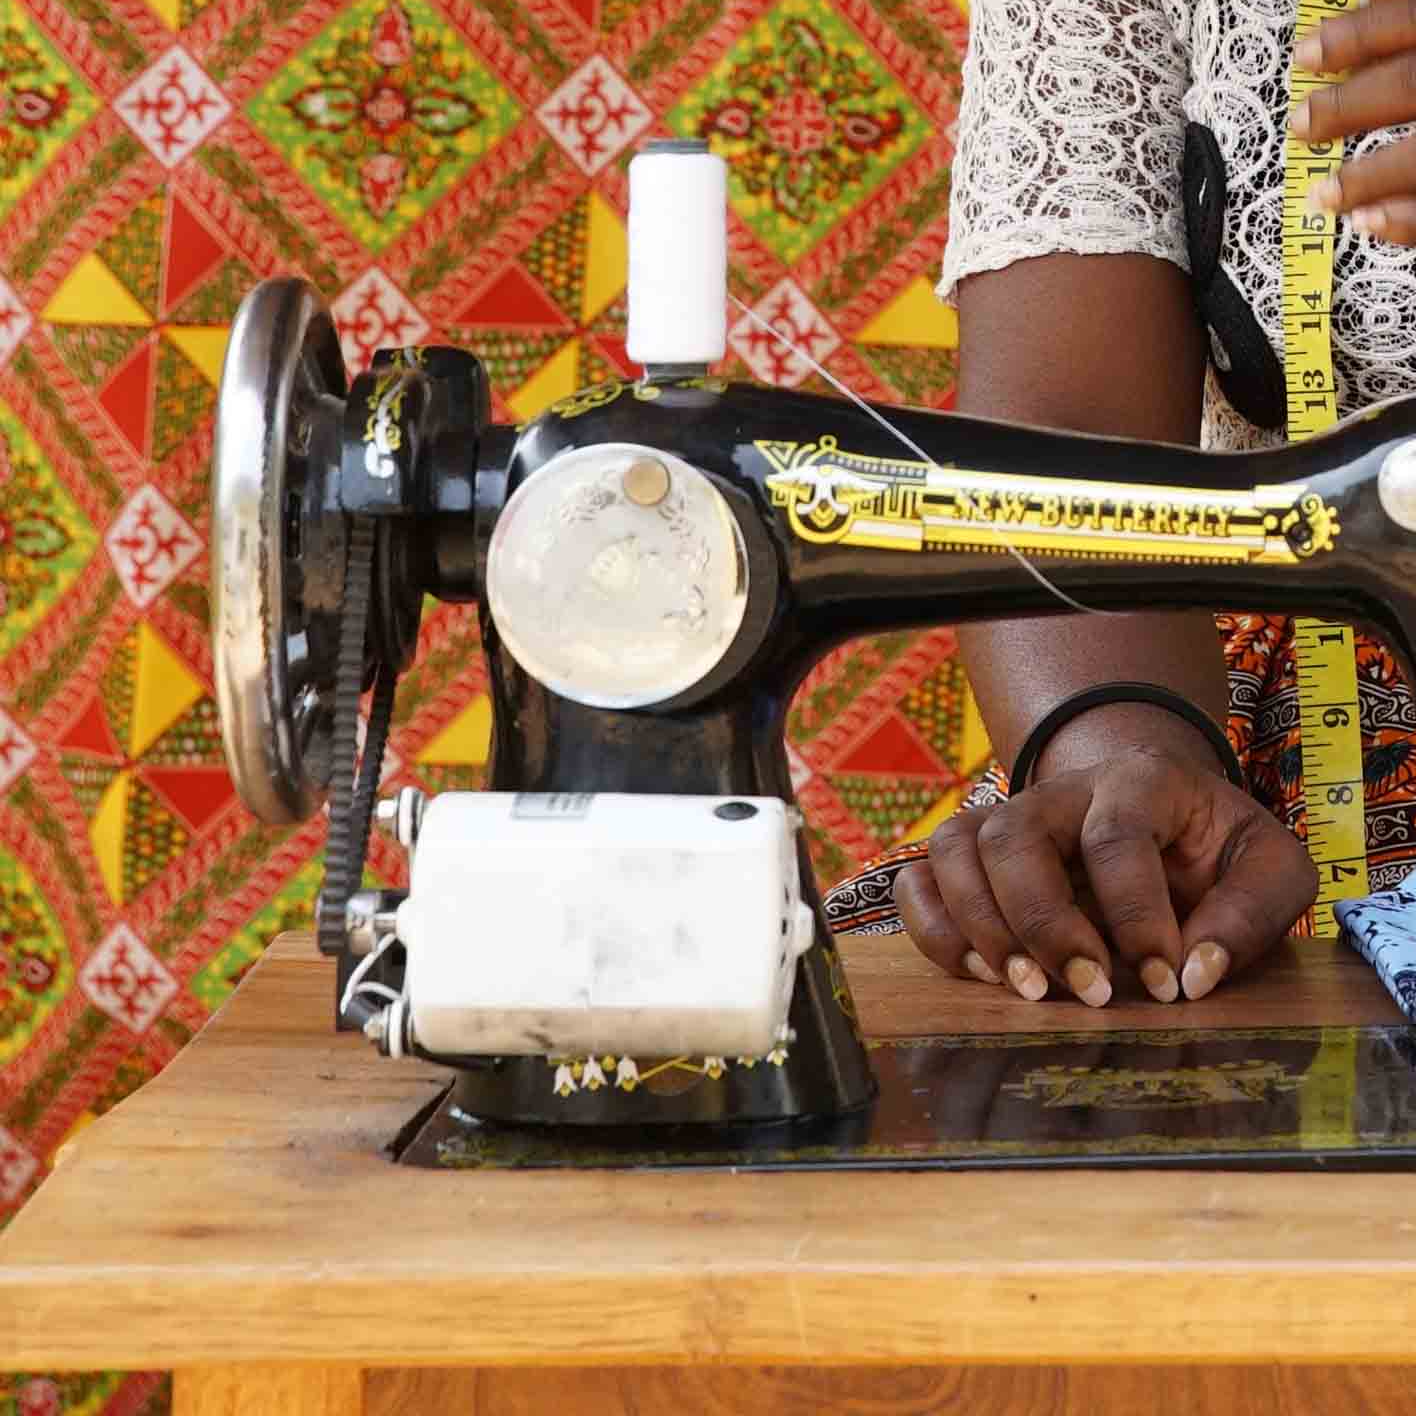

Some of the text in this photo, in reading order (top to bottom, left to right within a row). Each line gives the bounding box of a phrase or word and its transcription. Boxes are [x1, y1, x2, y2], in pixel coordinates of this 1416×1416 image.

[1302, 213, 1328, 255] 15
[1299, 289, 1325, 333] 14
[1302, 369, 1328, 411] 13
[1039, 495, 1234, 538] BUTTERFLY
[1322, 707, 1350, 728] 9
[1327, 785, 1354, 806] 8
[1331, 863, 1358, 883] 7
